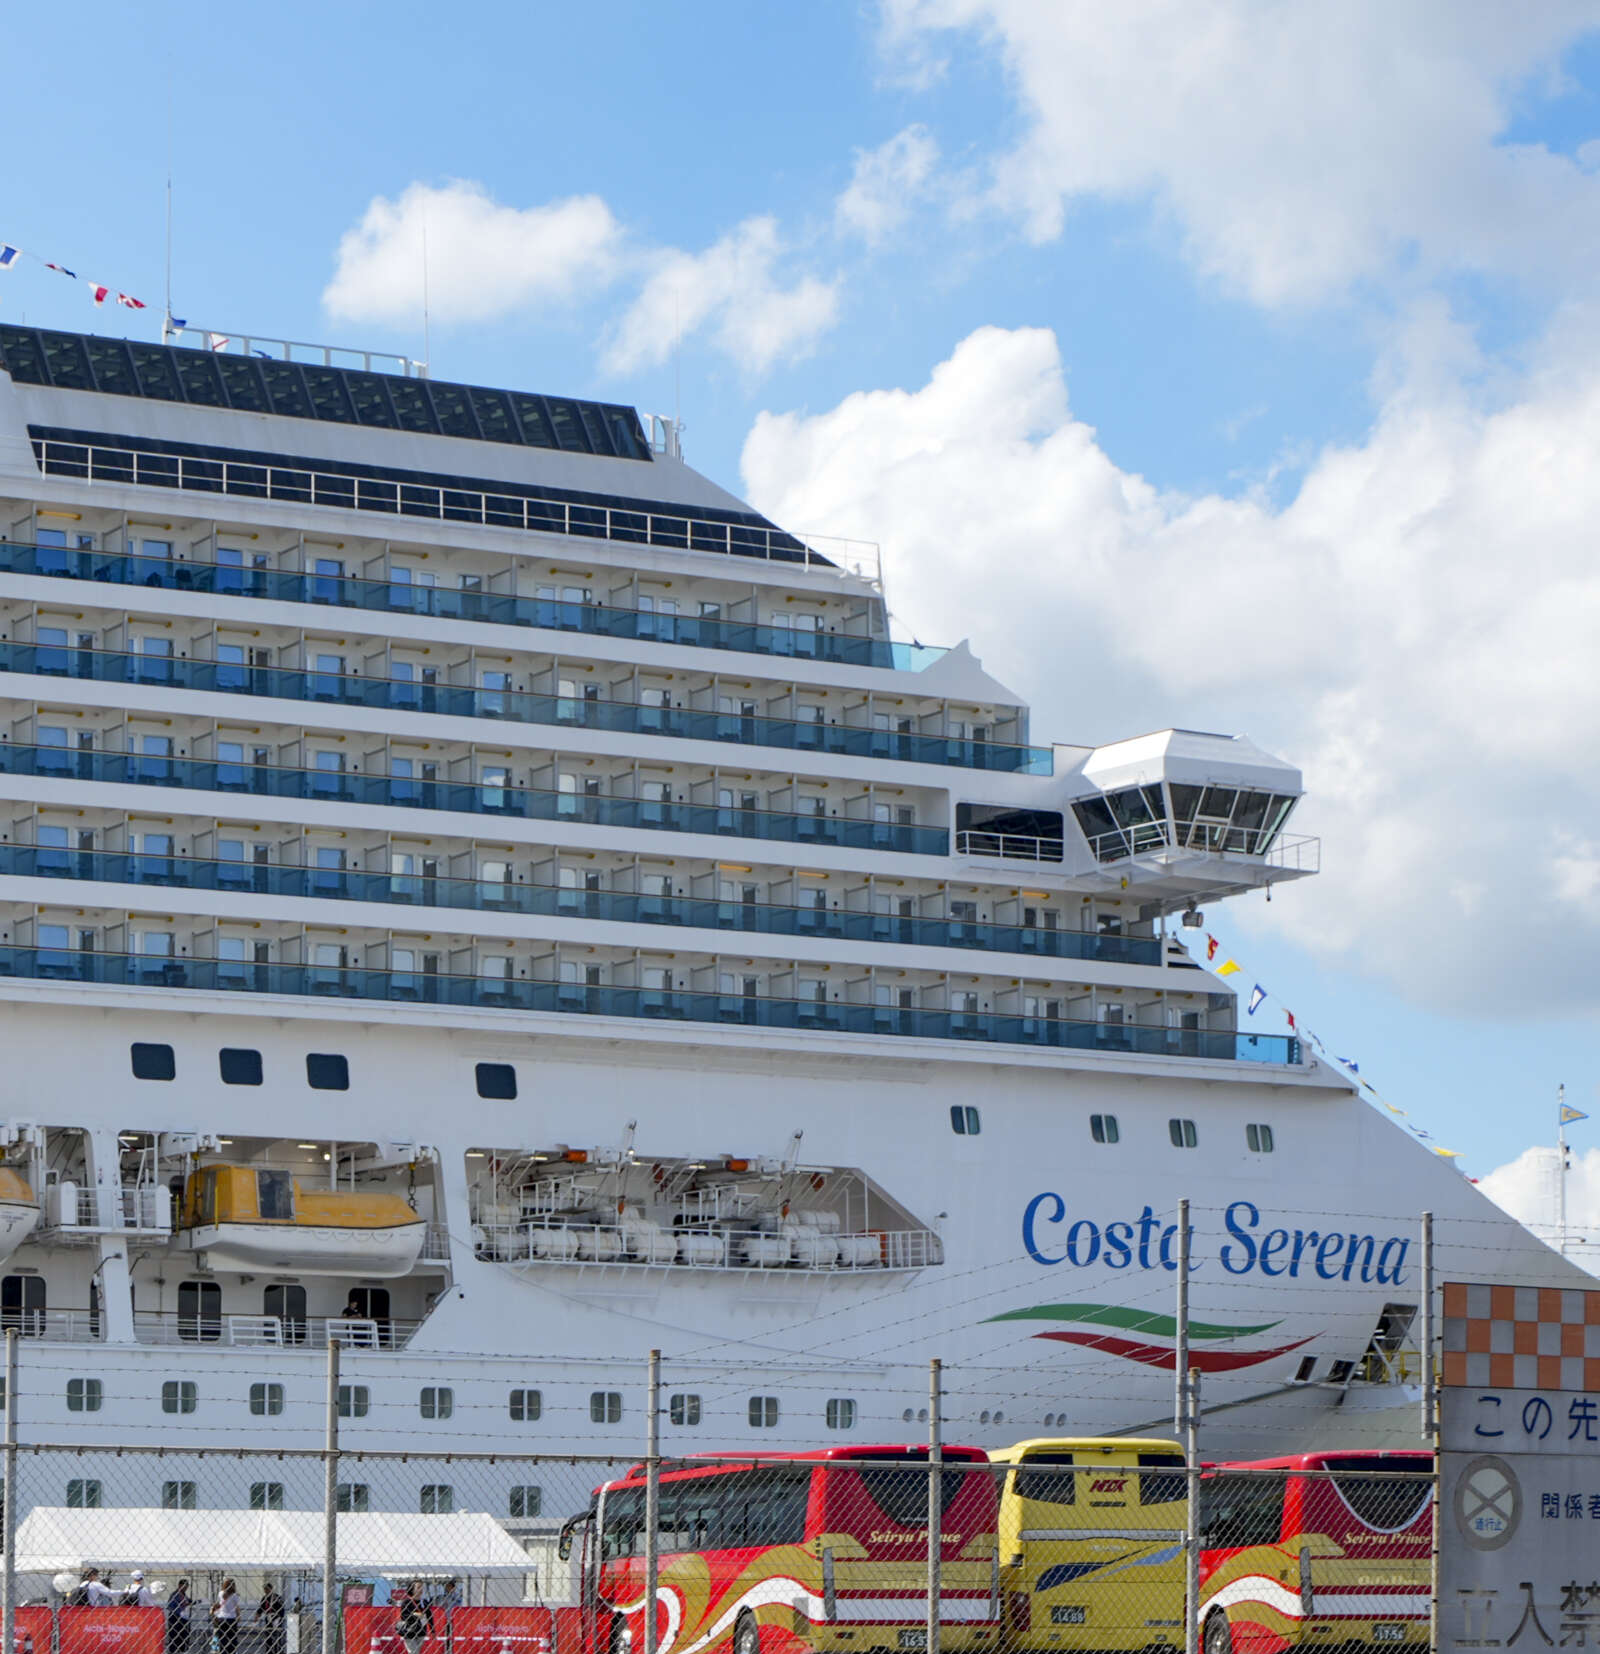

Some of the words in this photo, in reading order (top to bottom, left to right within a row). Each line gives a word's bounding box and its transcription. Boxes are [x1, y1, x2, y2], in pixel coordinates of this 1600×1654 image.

[1022, 1191, 1204, 1272] Costa
[1220, 1201, 1411, 1285] Serena
[1474, 1395, 1598, 1441] この先
[918, 1531, 961, 1544] Pnce
[1343, 1532, 1387, 1546] Seiryu
